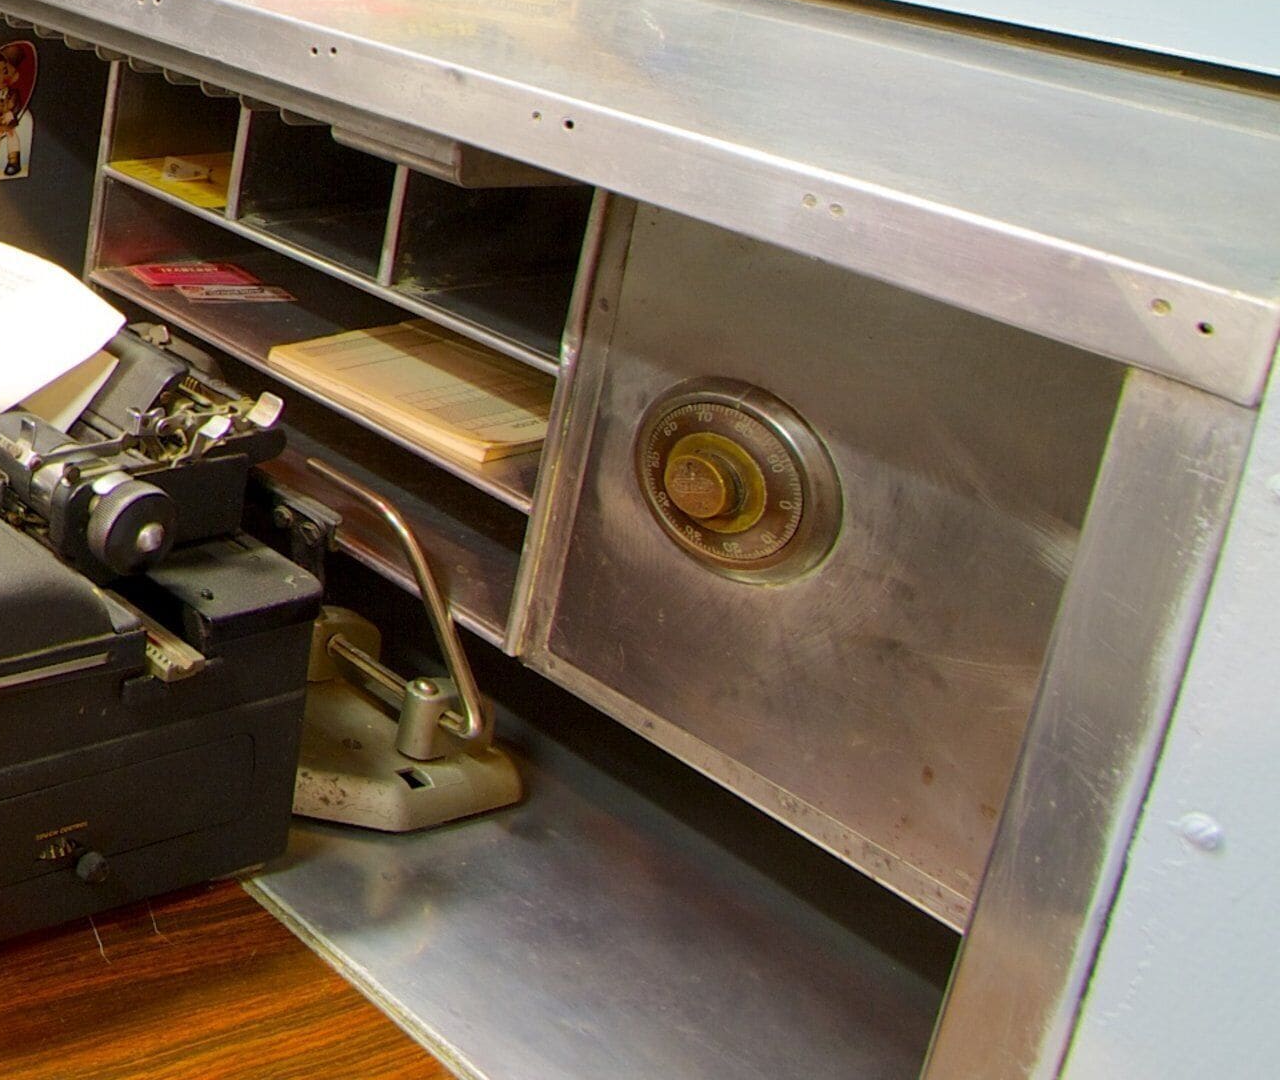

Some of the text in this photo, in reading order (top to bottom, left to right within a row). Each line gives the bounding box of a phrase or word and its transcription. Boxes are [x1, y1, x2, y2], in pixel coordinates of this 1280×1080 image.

[695, 410, 713, 423] 70
[663, 421, 678, 437] 60
[779, 500, 792, 510] 0
